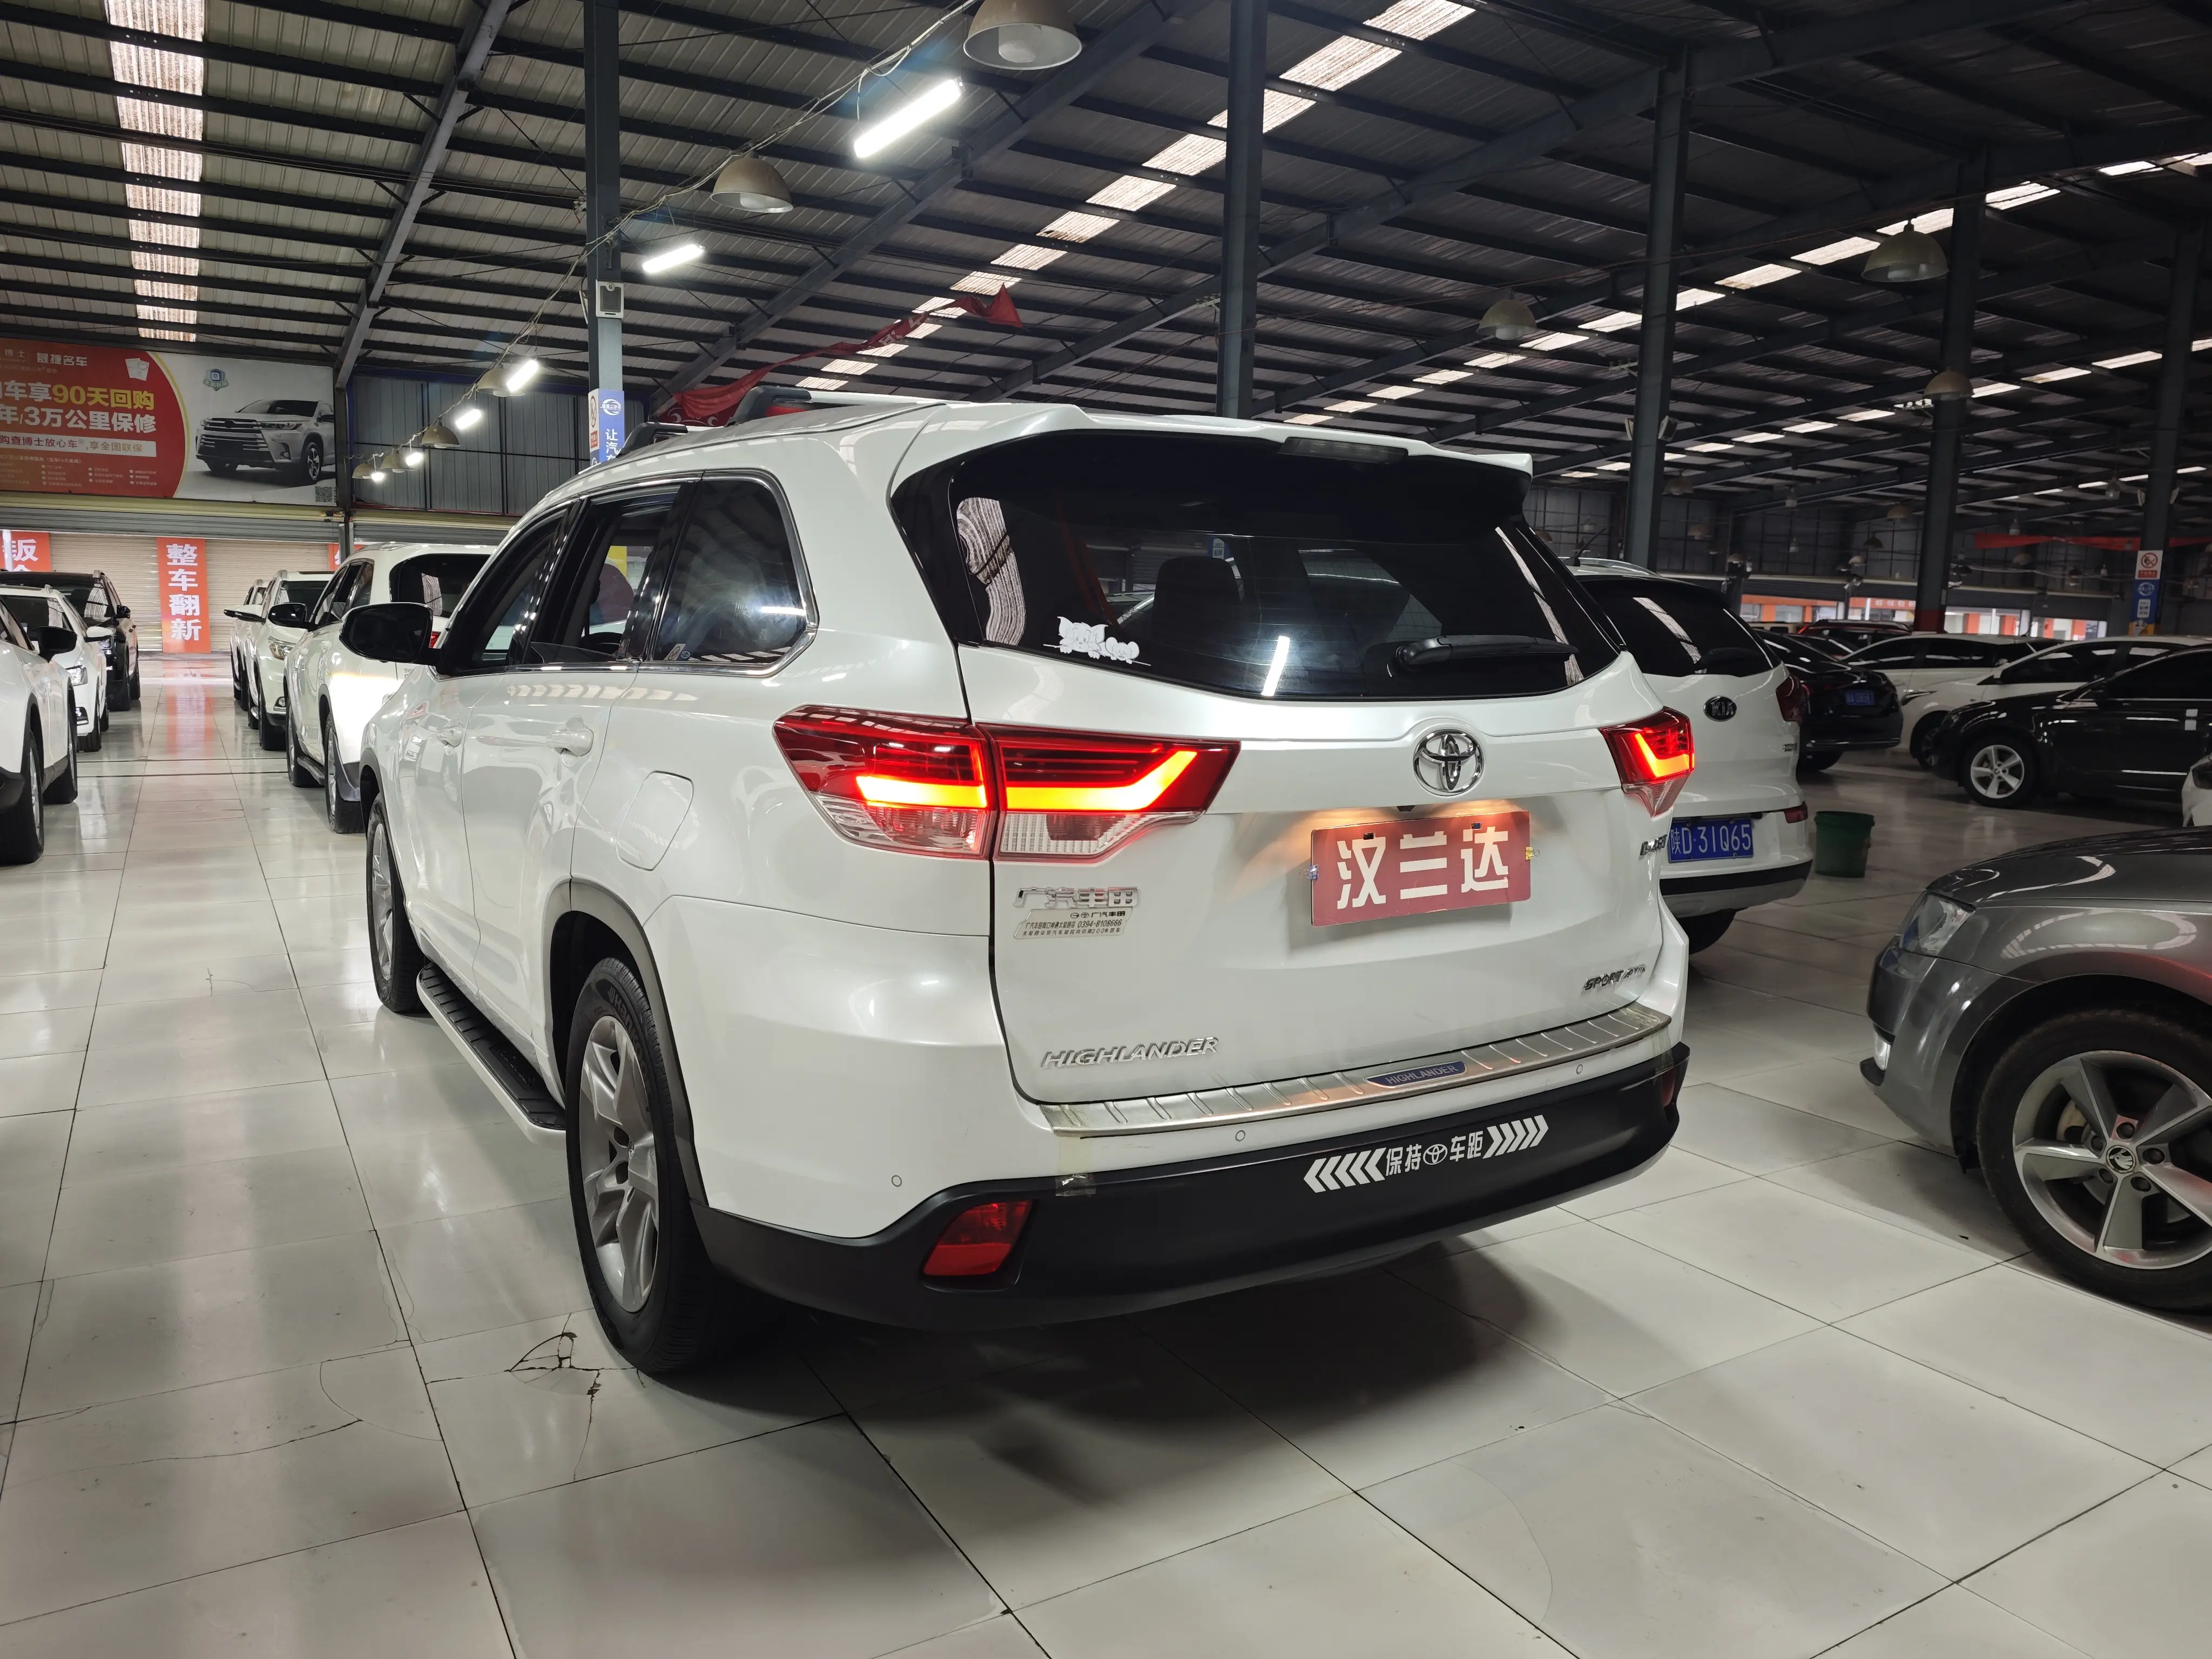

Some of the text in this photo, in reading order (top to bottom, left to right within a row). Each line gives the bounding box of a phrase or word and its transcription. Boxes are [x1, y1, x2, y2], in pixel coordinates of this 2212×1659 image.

[0, 380, 155, 410] 车享90天回购
[166, 543, 202, 642] 整车翻新
[1710, 702, 1734, 716] KIA
[1336, 826, 1509, 910] 汉兰达
[1013, 887, 1139, 908] 广汽丰田
[1077, 919, 1122, 928] 0394-8108666
[1583, 969, 1624, 991] SPORT
[1041, 1036, 1219, 1069] HIGHLANDER
[1385, 1065, 1459, 1084] HIGHLANDER
[1385, 1131, 1484, 1176] 保持 车距
